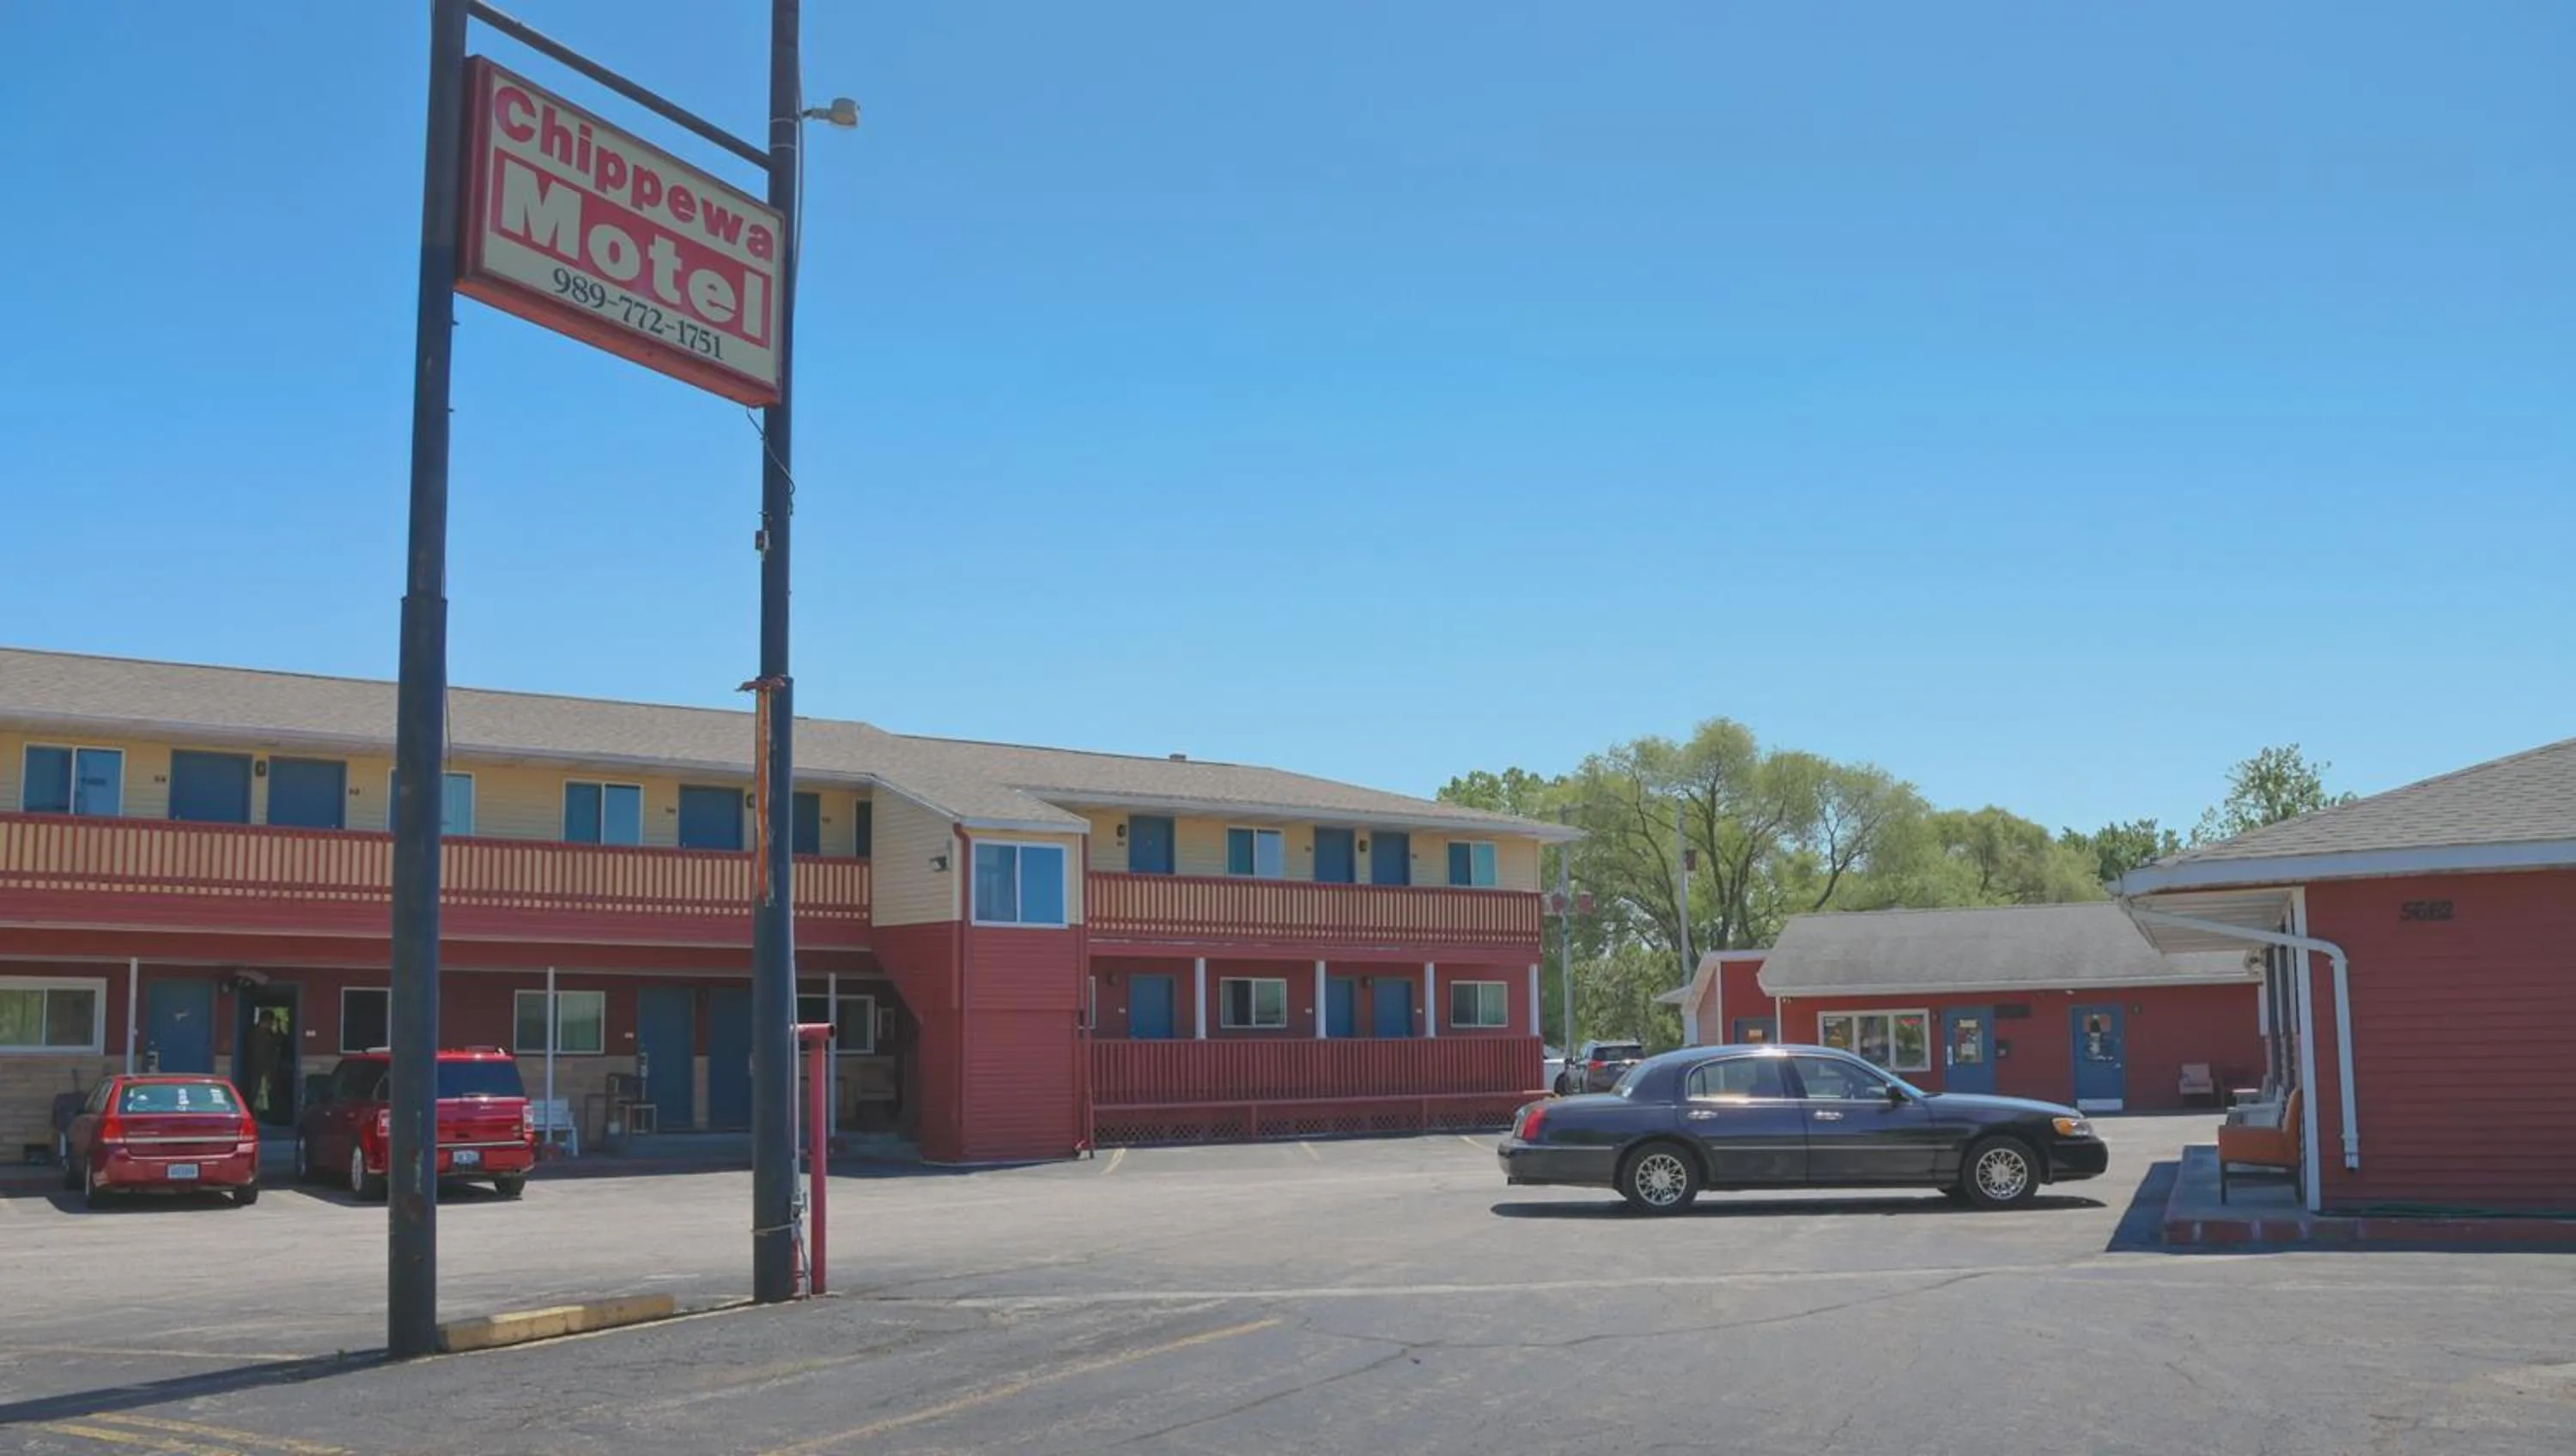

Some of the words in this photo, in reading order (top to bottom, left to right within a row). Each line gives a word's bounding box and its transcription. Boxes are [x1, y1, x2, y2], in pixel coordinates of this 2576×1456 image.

[494, 86, 773, 263] Chippewa
[500, 158, 763, 338] Motel
[553, 268, 723, 361] 989-772-1751
